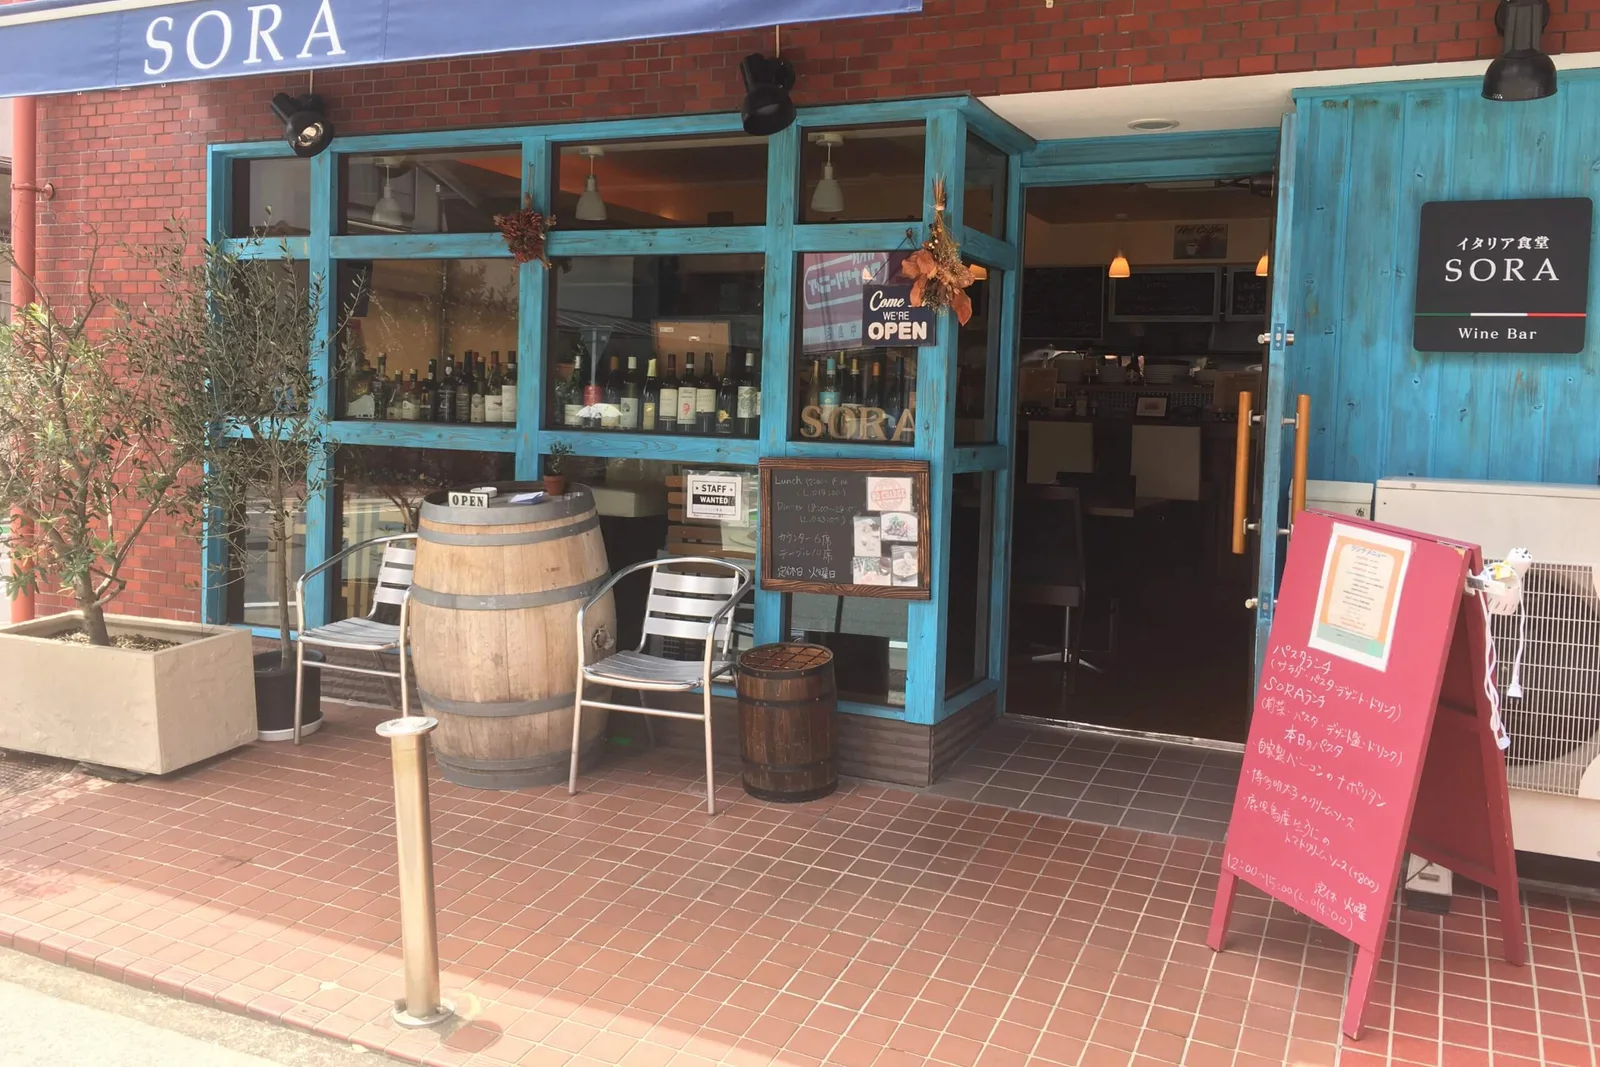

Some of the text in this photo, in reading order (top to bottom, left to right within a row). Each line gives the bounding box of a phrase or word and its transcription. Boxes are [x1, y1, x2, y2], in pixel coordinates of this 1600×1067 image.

[144, 0, 346, 75] SORA
[1457, 236, 1550, 250] イタリア食堂
[1445, 258, 1559, 282] SORA
[870, 290, 905, 311] Come
[883, 311, 909, 320] WE'RE
[868, 321, 927, 340] OPEN
[1458, 328, 1537, 339] Wine Bar
[800, 405, 914, 440] SORA
[774, 475, 802, 485] Lunch
[701, 484, 727, 493] STAFF
[452, 494, 484, 507] OPEN
[700, 495, 728, 505] WANTED
